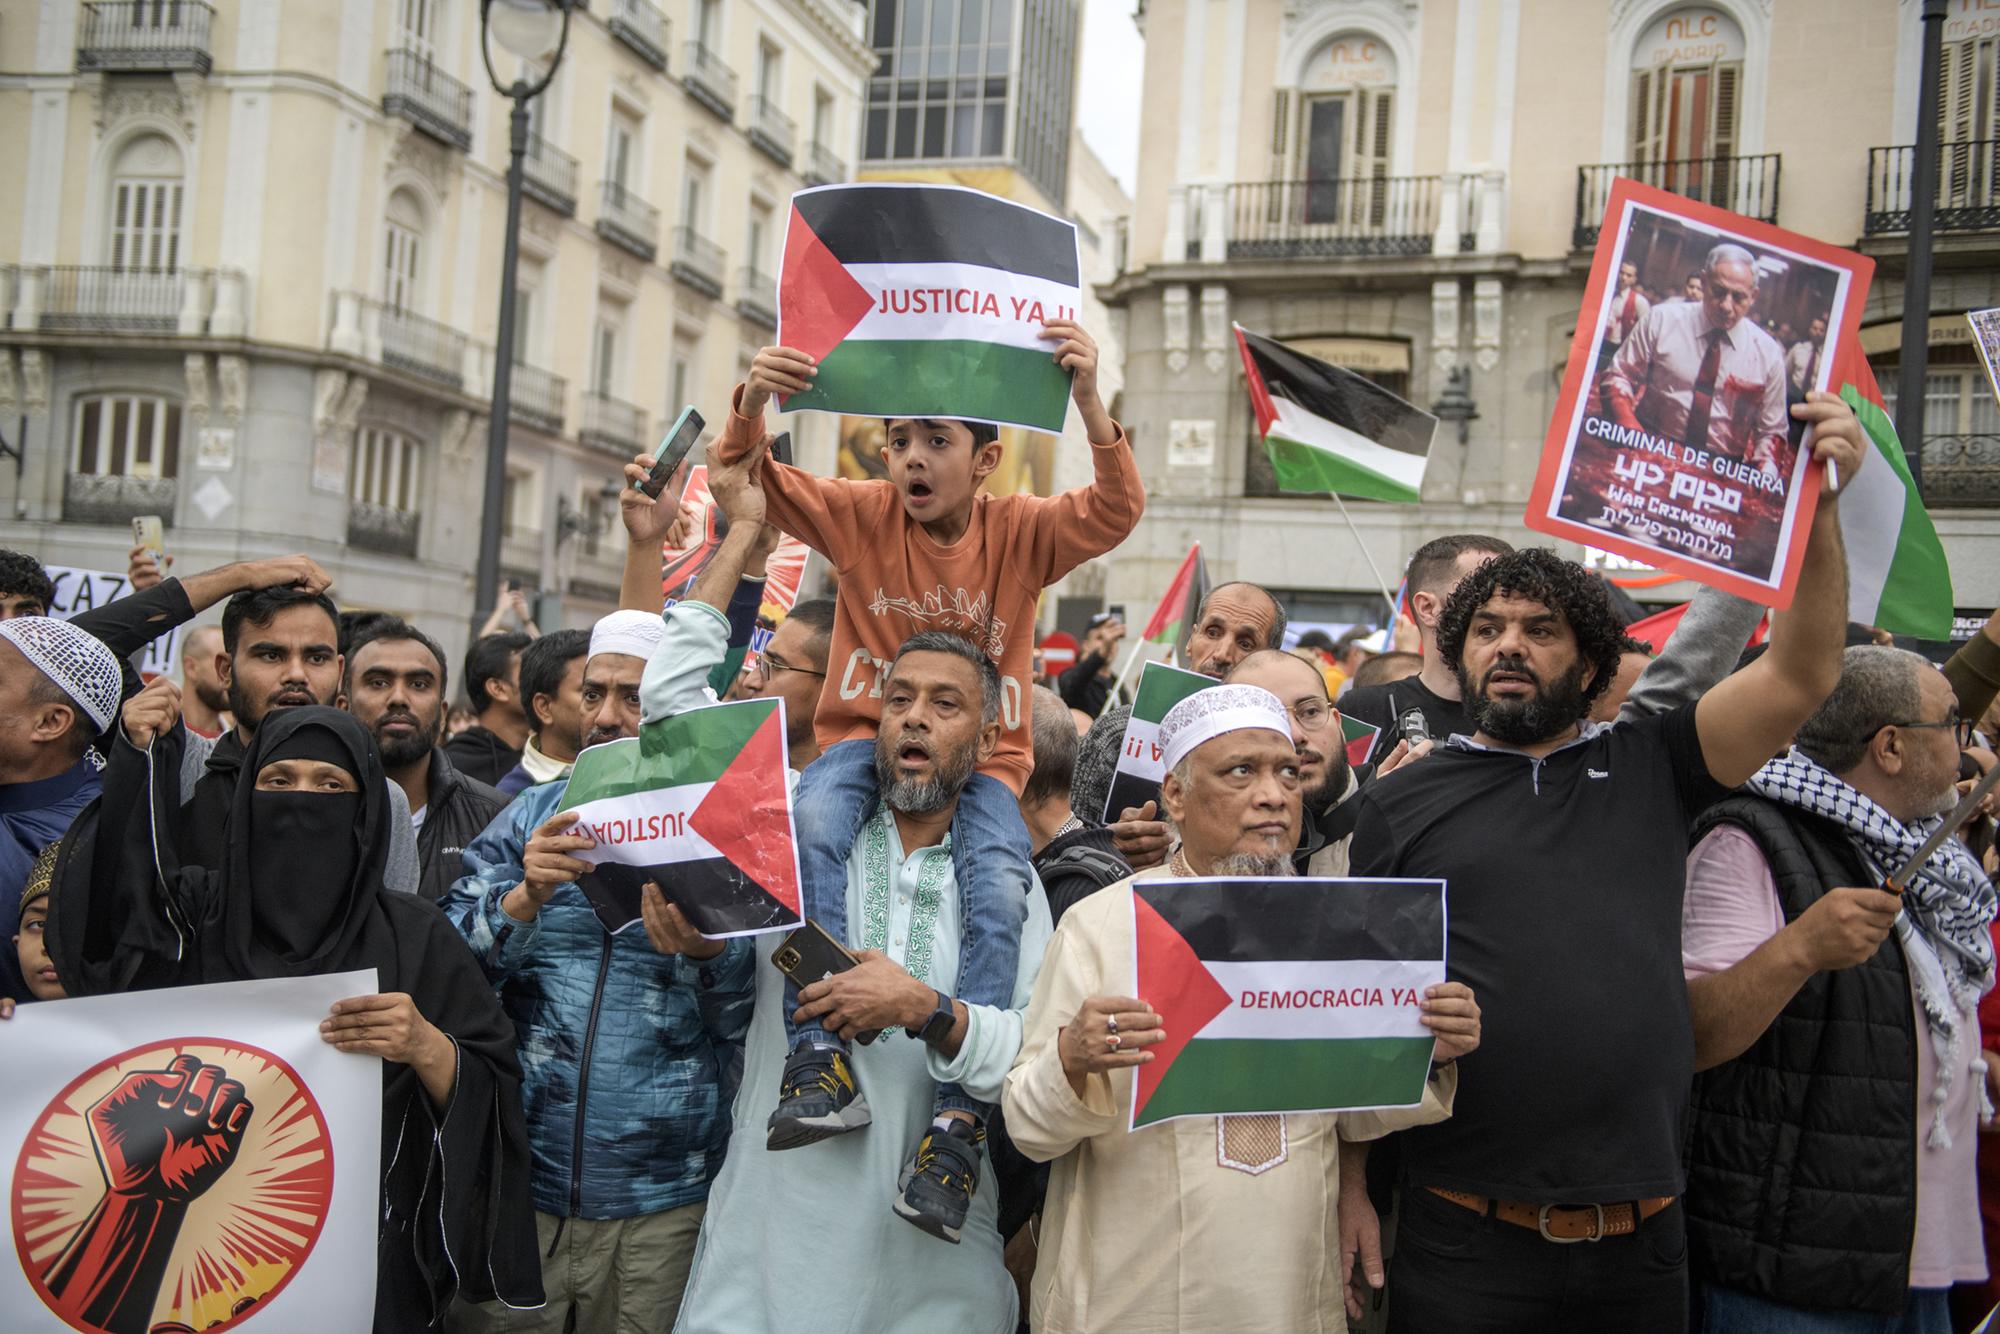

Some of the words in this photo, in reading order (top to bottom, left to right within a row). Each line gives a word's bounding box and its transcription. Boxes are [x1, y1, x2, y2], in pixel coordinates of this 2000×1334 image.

[879, 288, 1001, 318] JUSTICIA
[1010, 296, 1046, 326] YA
[1584, 416, 1678, 460] CRIMINAL
[1682, 446, 1710, 469] DE
[1712, 456, 1785, 497] GUERRA
[591, 811, 686, 845] JUSTICIA
[1239, 987, 1384, 1009] DEMOCRACIA
[1390, 987, 1419, 1007] YA
